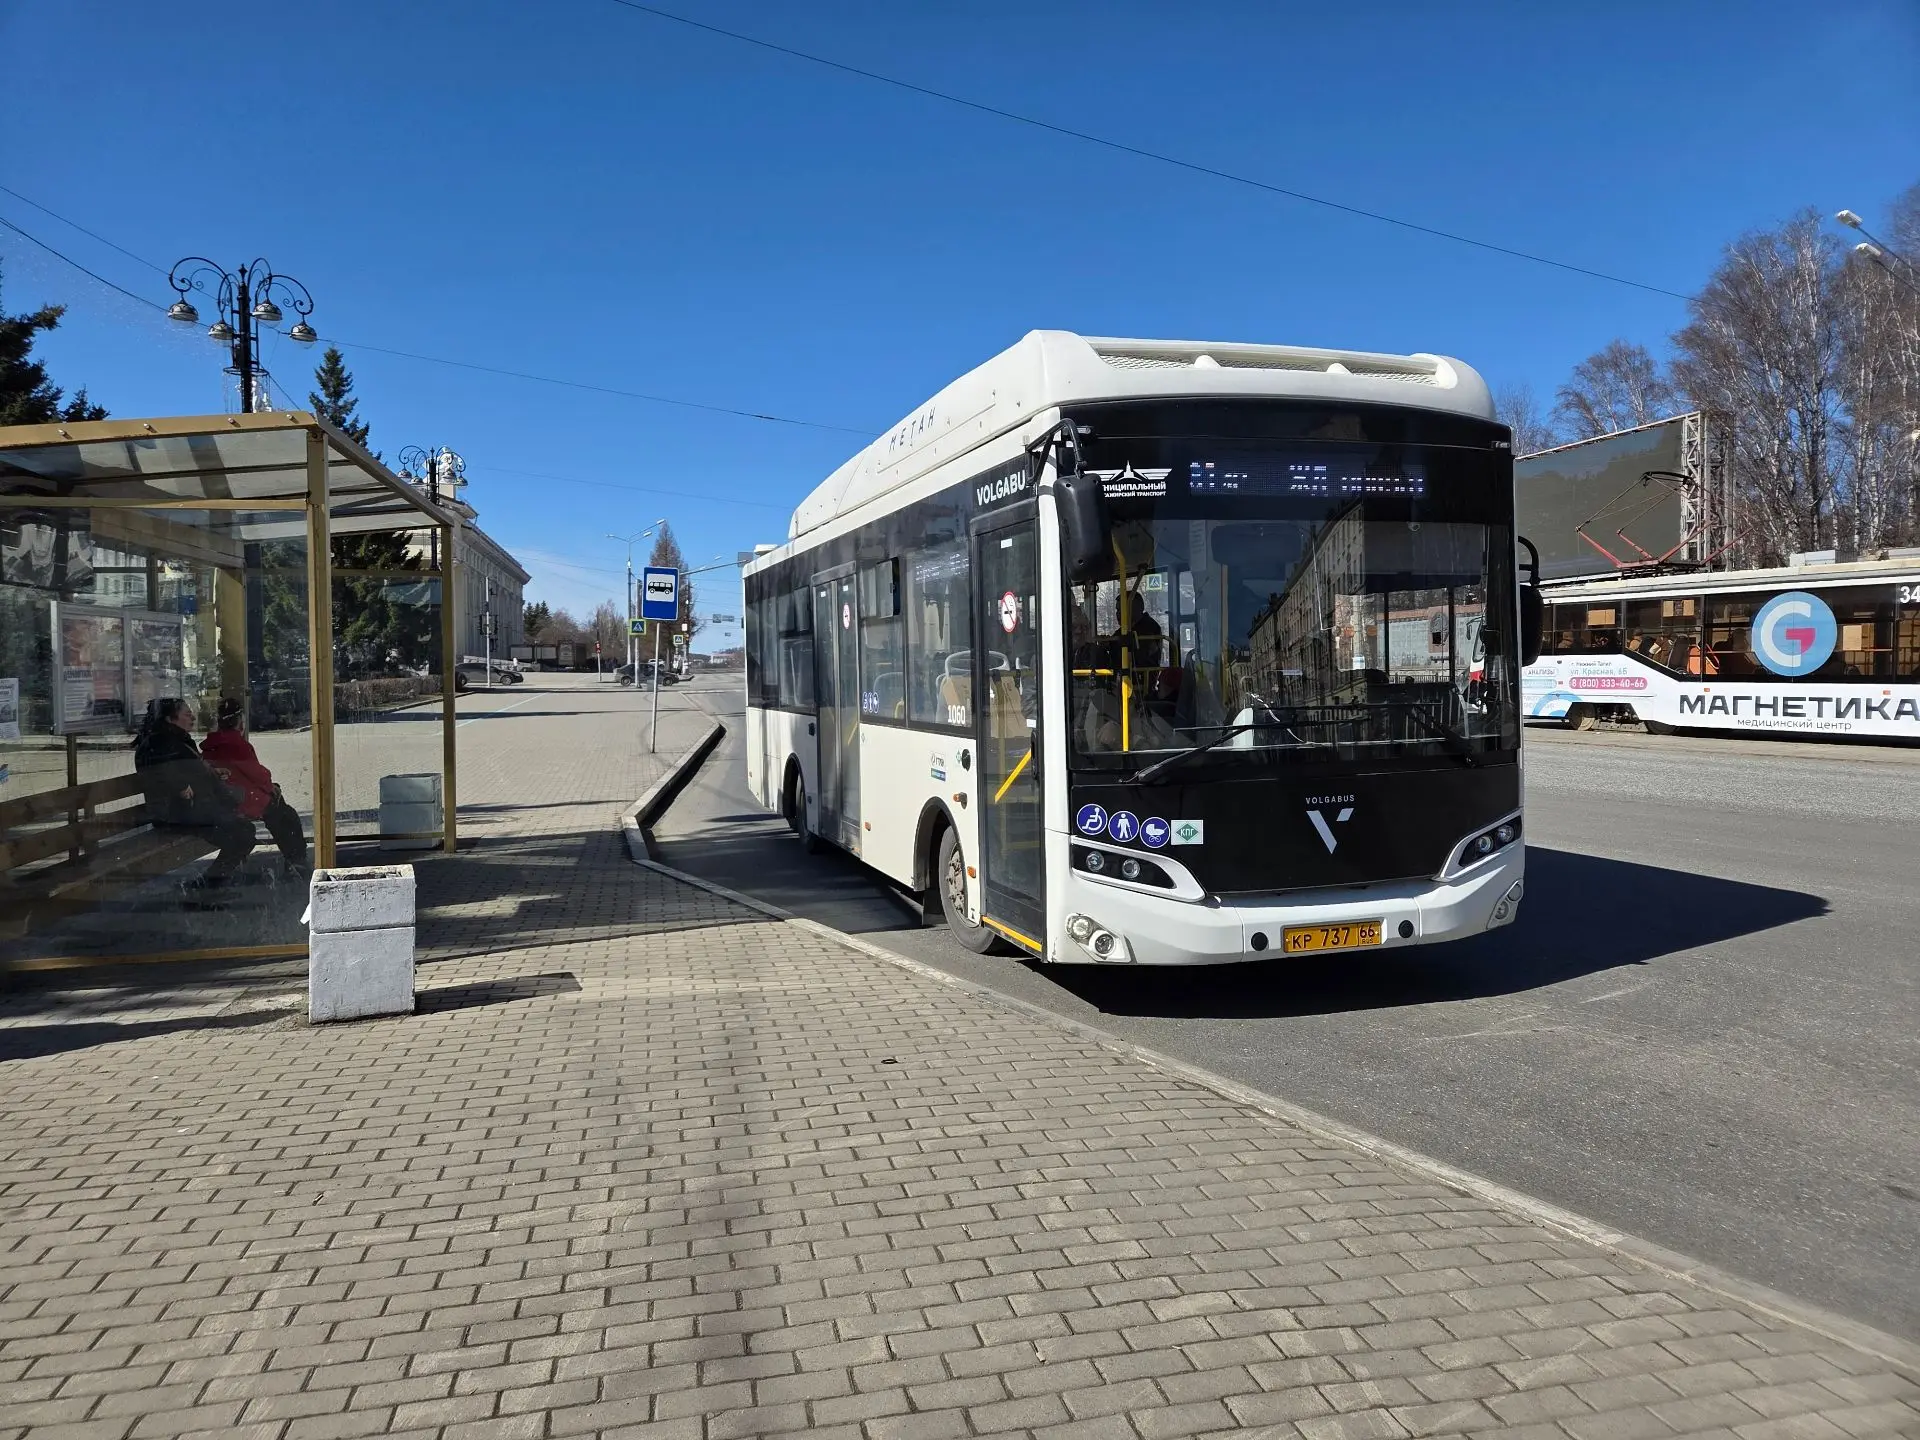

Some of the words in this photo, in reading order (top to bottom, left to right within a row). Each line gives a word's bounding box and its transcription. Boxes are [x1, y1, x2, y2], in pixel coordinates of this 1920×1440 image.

[888, 407, 936, 453] МЕТАН
[976, 469, 1029, 506] VOLGABU
[1102, 481, 1167, 492] НИЦИПАЛЬНЫЙ
[1571, 678, 1577, 687] 8
[1579, 678, 1599, 688] (800)
[1601, 678, 1645, 688] 333-40-66
[947, 704, 966, 725] 1060
[1679, 694, 1920, 722] МАГНЕТИКА
[1737, 718, 1813, 729] медицинский
[1816, 720, 1852, 732] центр
[1305, 794, 1356, 805] VOLGABUS
[1180, 828, 1194, 836] КПГ
[1320, 927, 1351, 947] 737
[1360, 924, 1375, 938] 66
